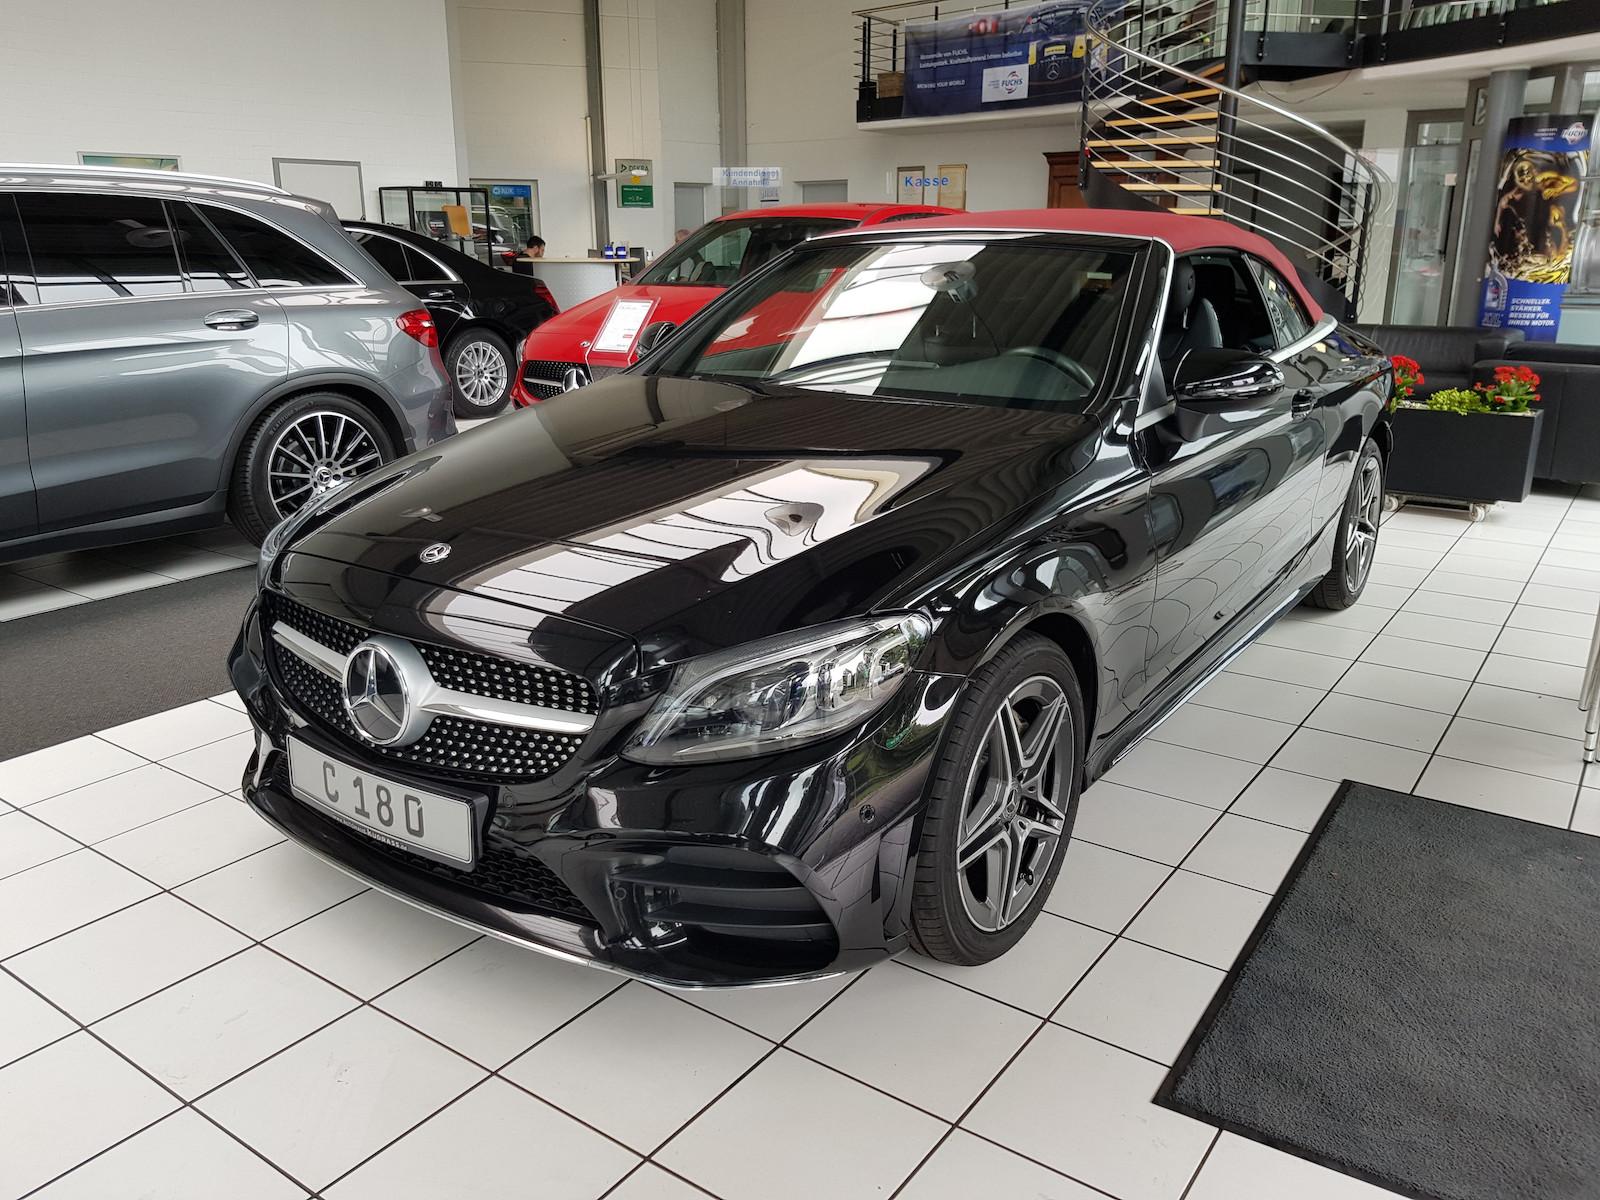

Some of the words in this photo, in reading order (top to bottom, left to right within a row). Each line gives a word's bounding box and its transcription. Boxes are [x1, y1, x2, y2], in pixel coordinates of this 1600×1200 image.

[1001, 78, 1023, 86] FUCHS
[904, 176, 949, 187] Kasse
[1510, 304, 1542, 312] STÄRKER.
[1536, 311, 1550, 319] FÜR
[322, 760, 339, 803] C
[352, 775, 425, 838] 180
